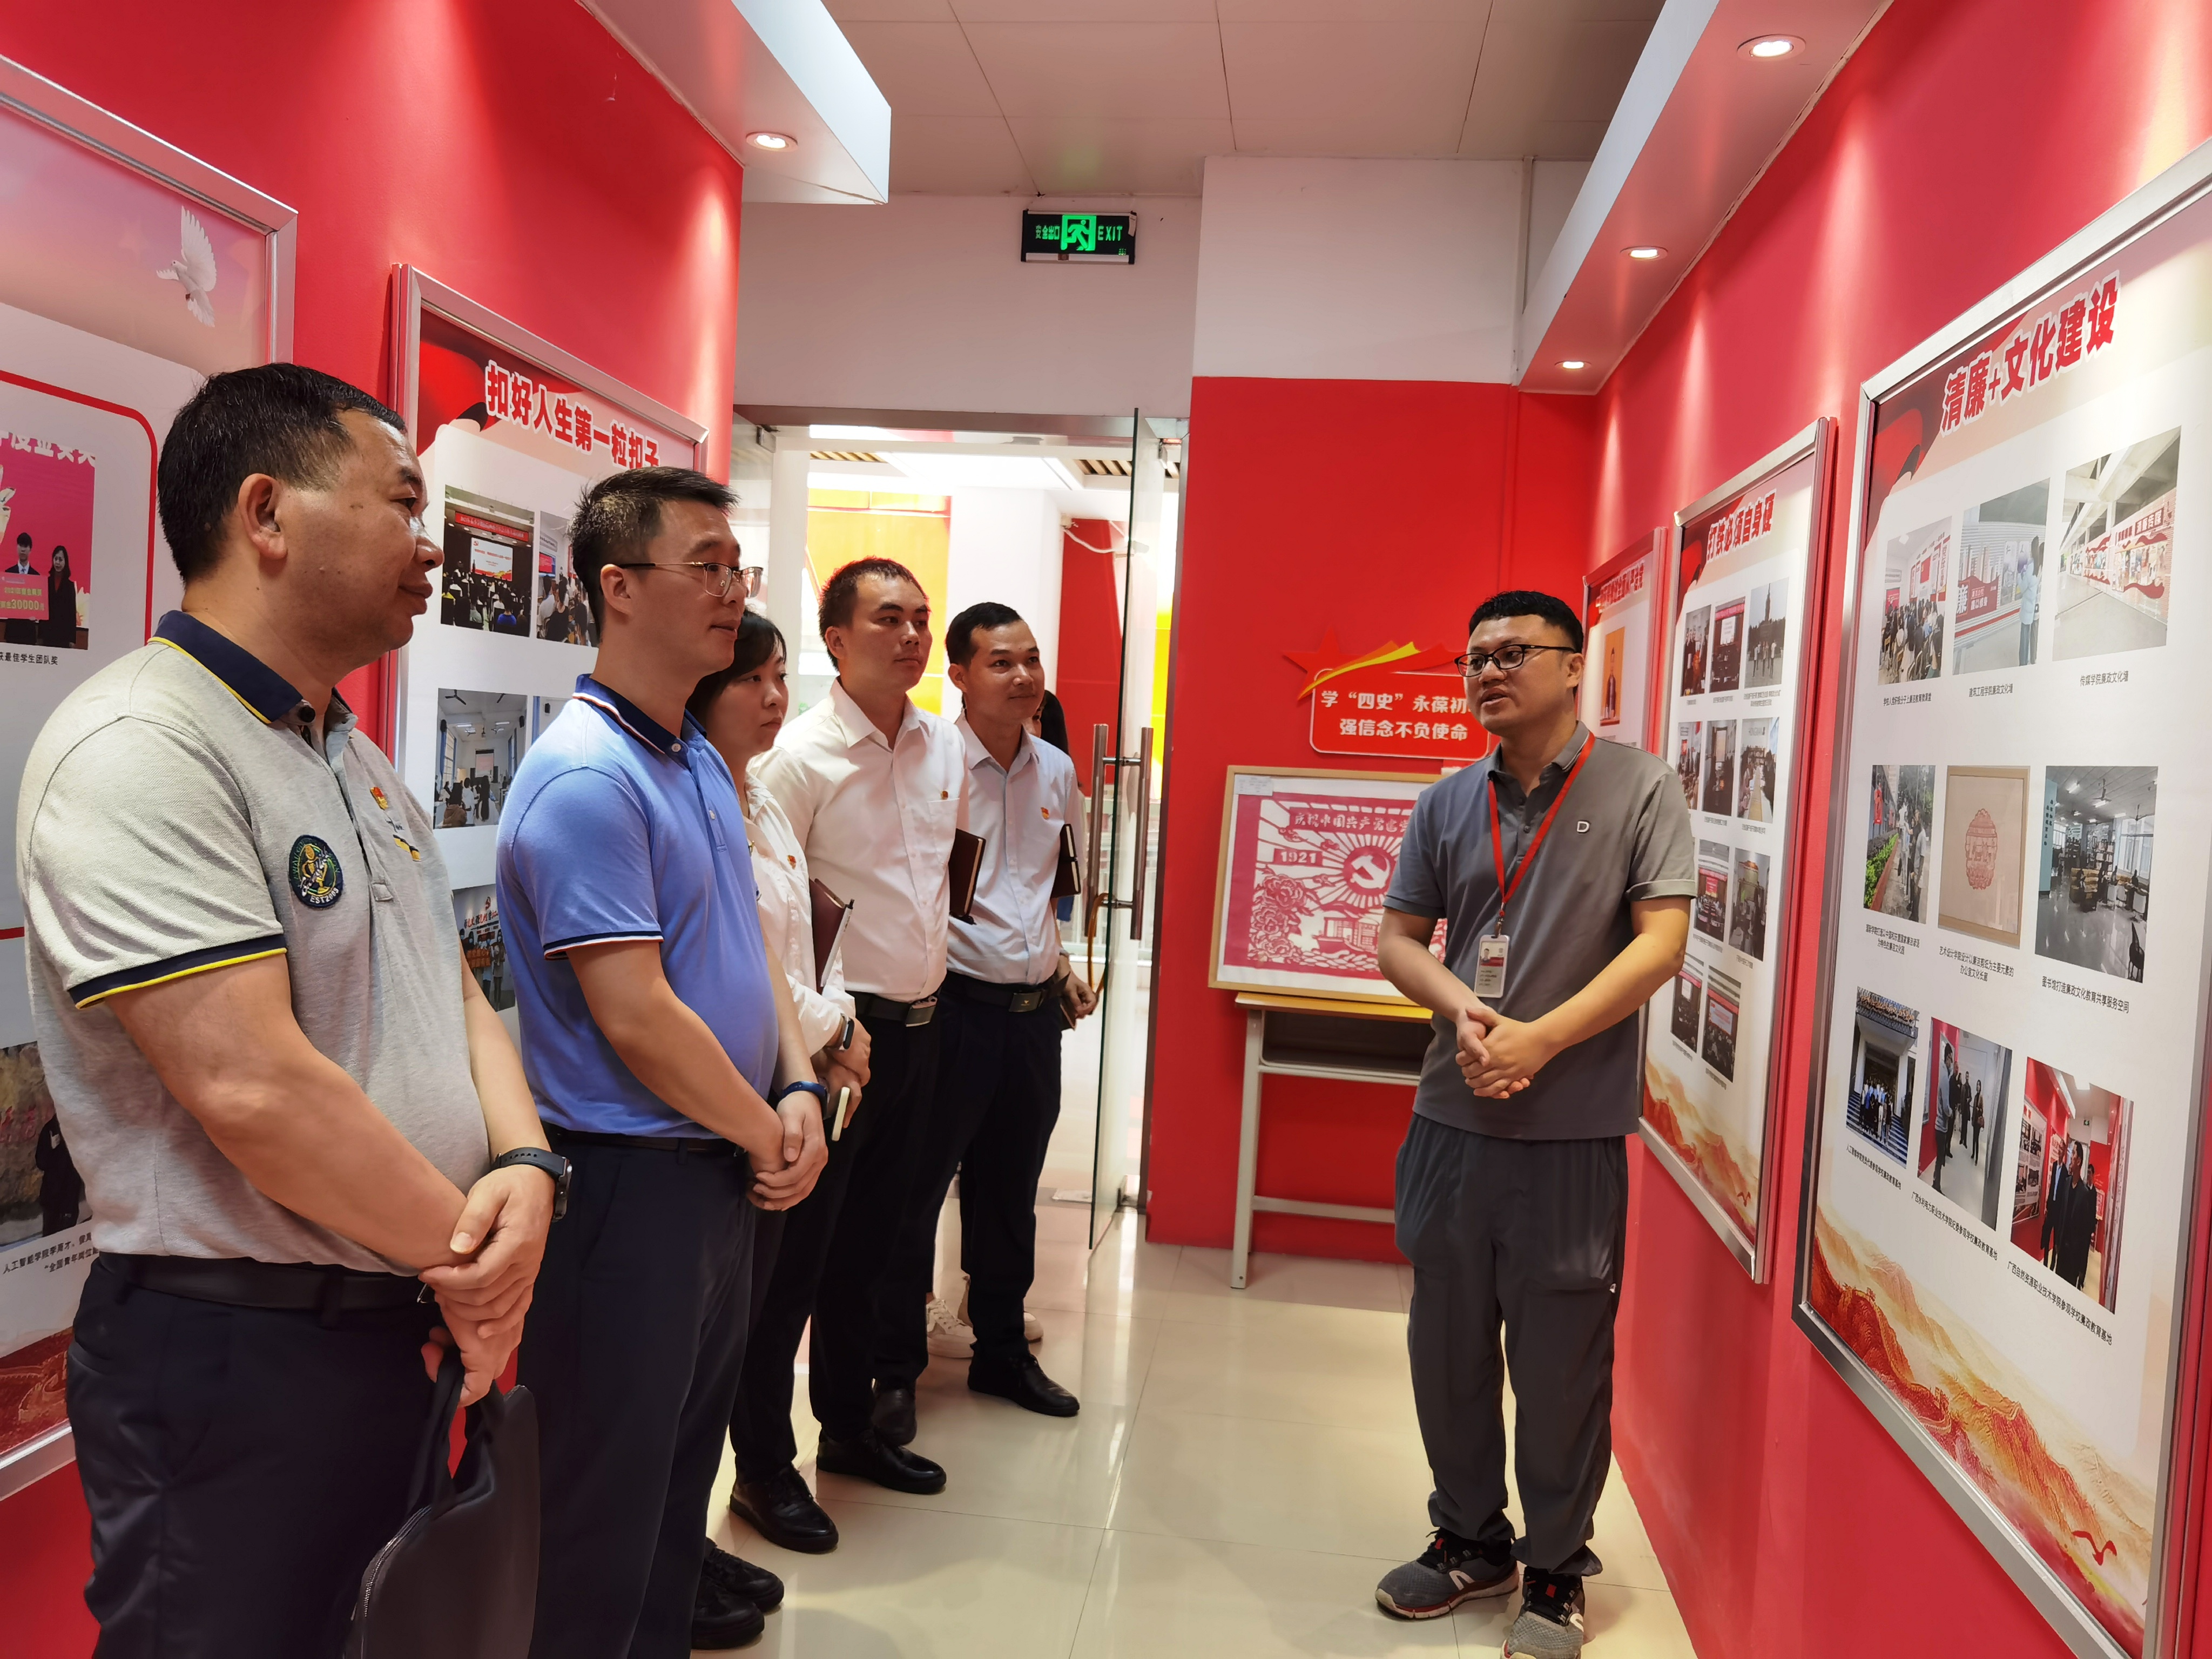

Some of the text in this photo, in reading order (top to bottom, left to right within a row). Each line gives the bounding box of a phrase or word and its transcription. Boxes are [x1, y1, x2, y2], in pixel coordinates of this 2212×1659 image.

[1035, 225, 1123, 241] 安全出口 EXIT
[1941, 274, 2120, 434] 清廉+文化建设
[486, 362, 660, 469] 扣好人生第一粒扣子
[1321, 691, 1472, 714] 学“四史”永葆初
[1339, 718, 1468, 741] 强信念不负使命
[1576, 821, 1590, 833] D
[1280, 851, 1317, 865] 1921
